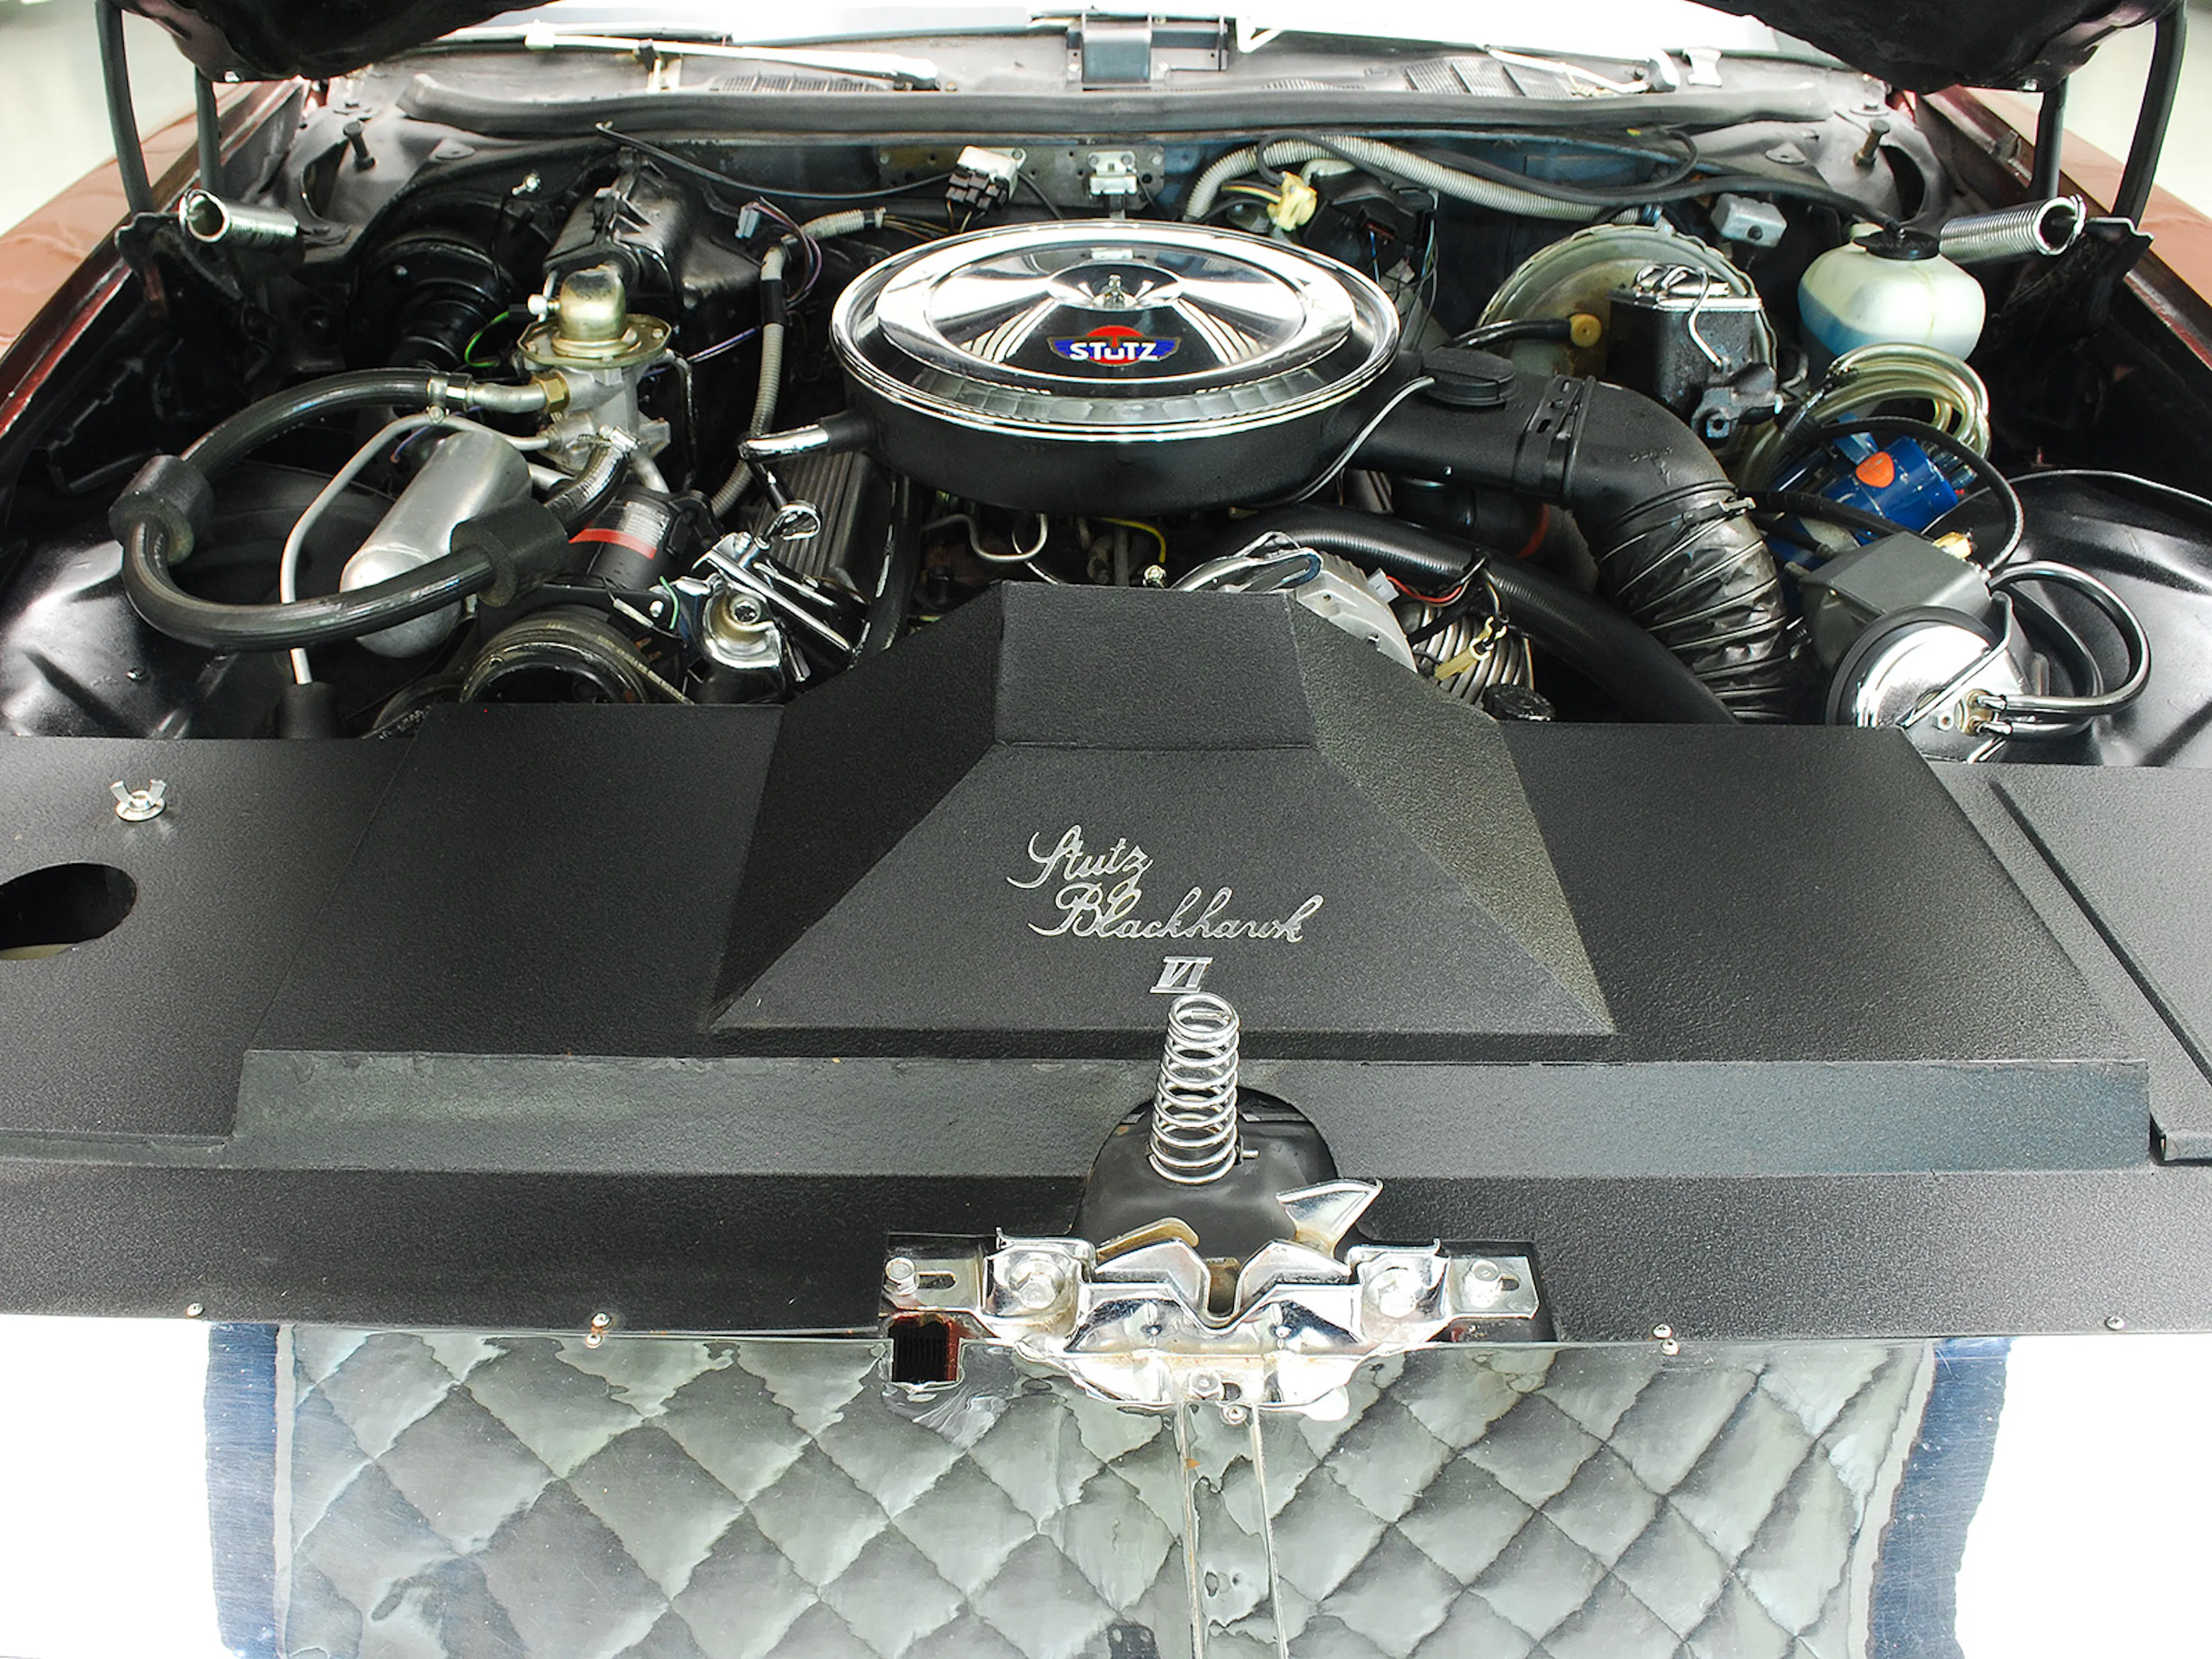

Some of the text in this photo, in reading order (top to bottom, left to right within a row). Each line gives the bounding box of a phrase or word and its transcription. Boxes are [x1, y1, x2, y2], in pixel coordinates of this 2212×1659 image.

[1069, 342, 1158, 361] STUTZ
[1006, 824, 1153, 903] Stutz
[1028, 882, 1324, 943] Blackhawk
[1150, 956, 1213, 994] VI
